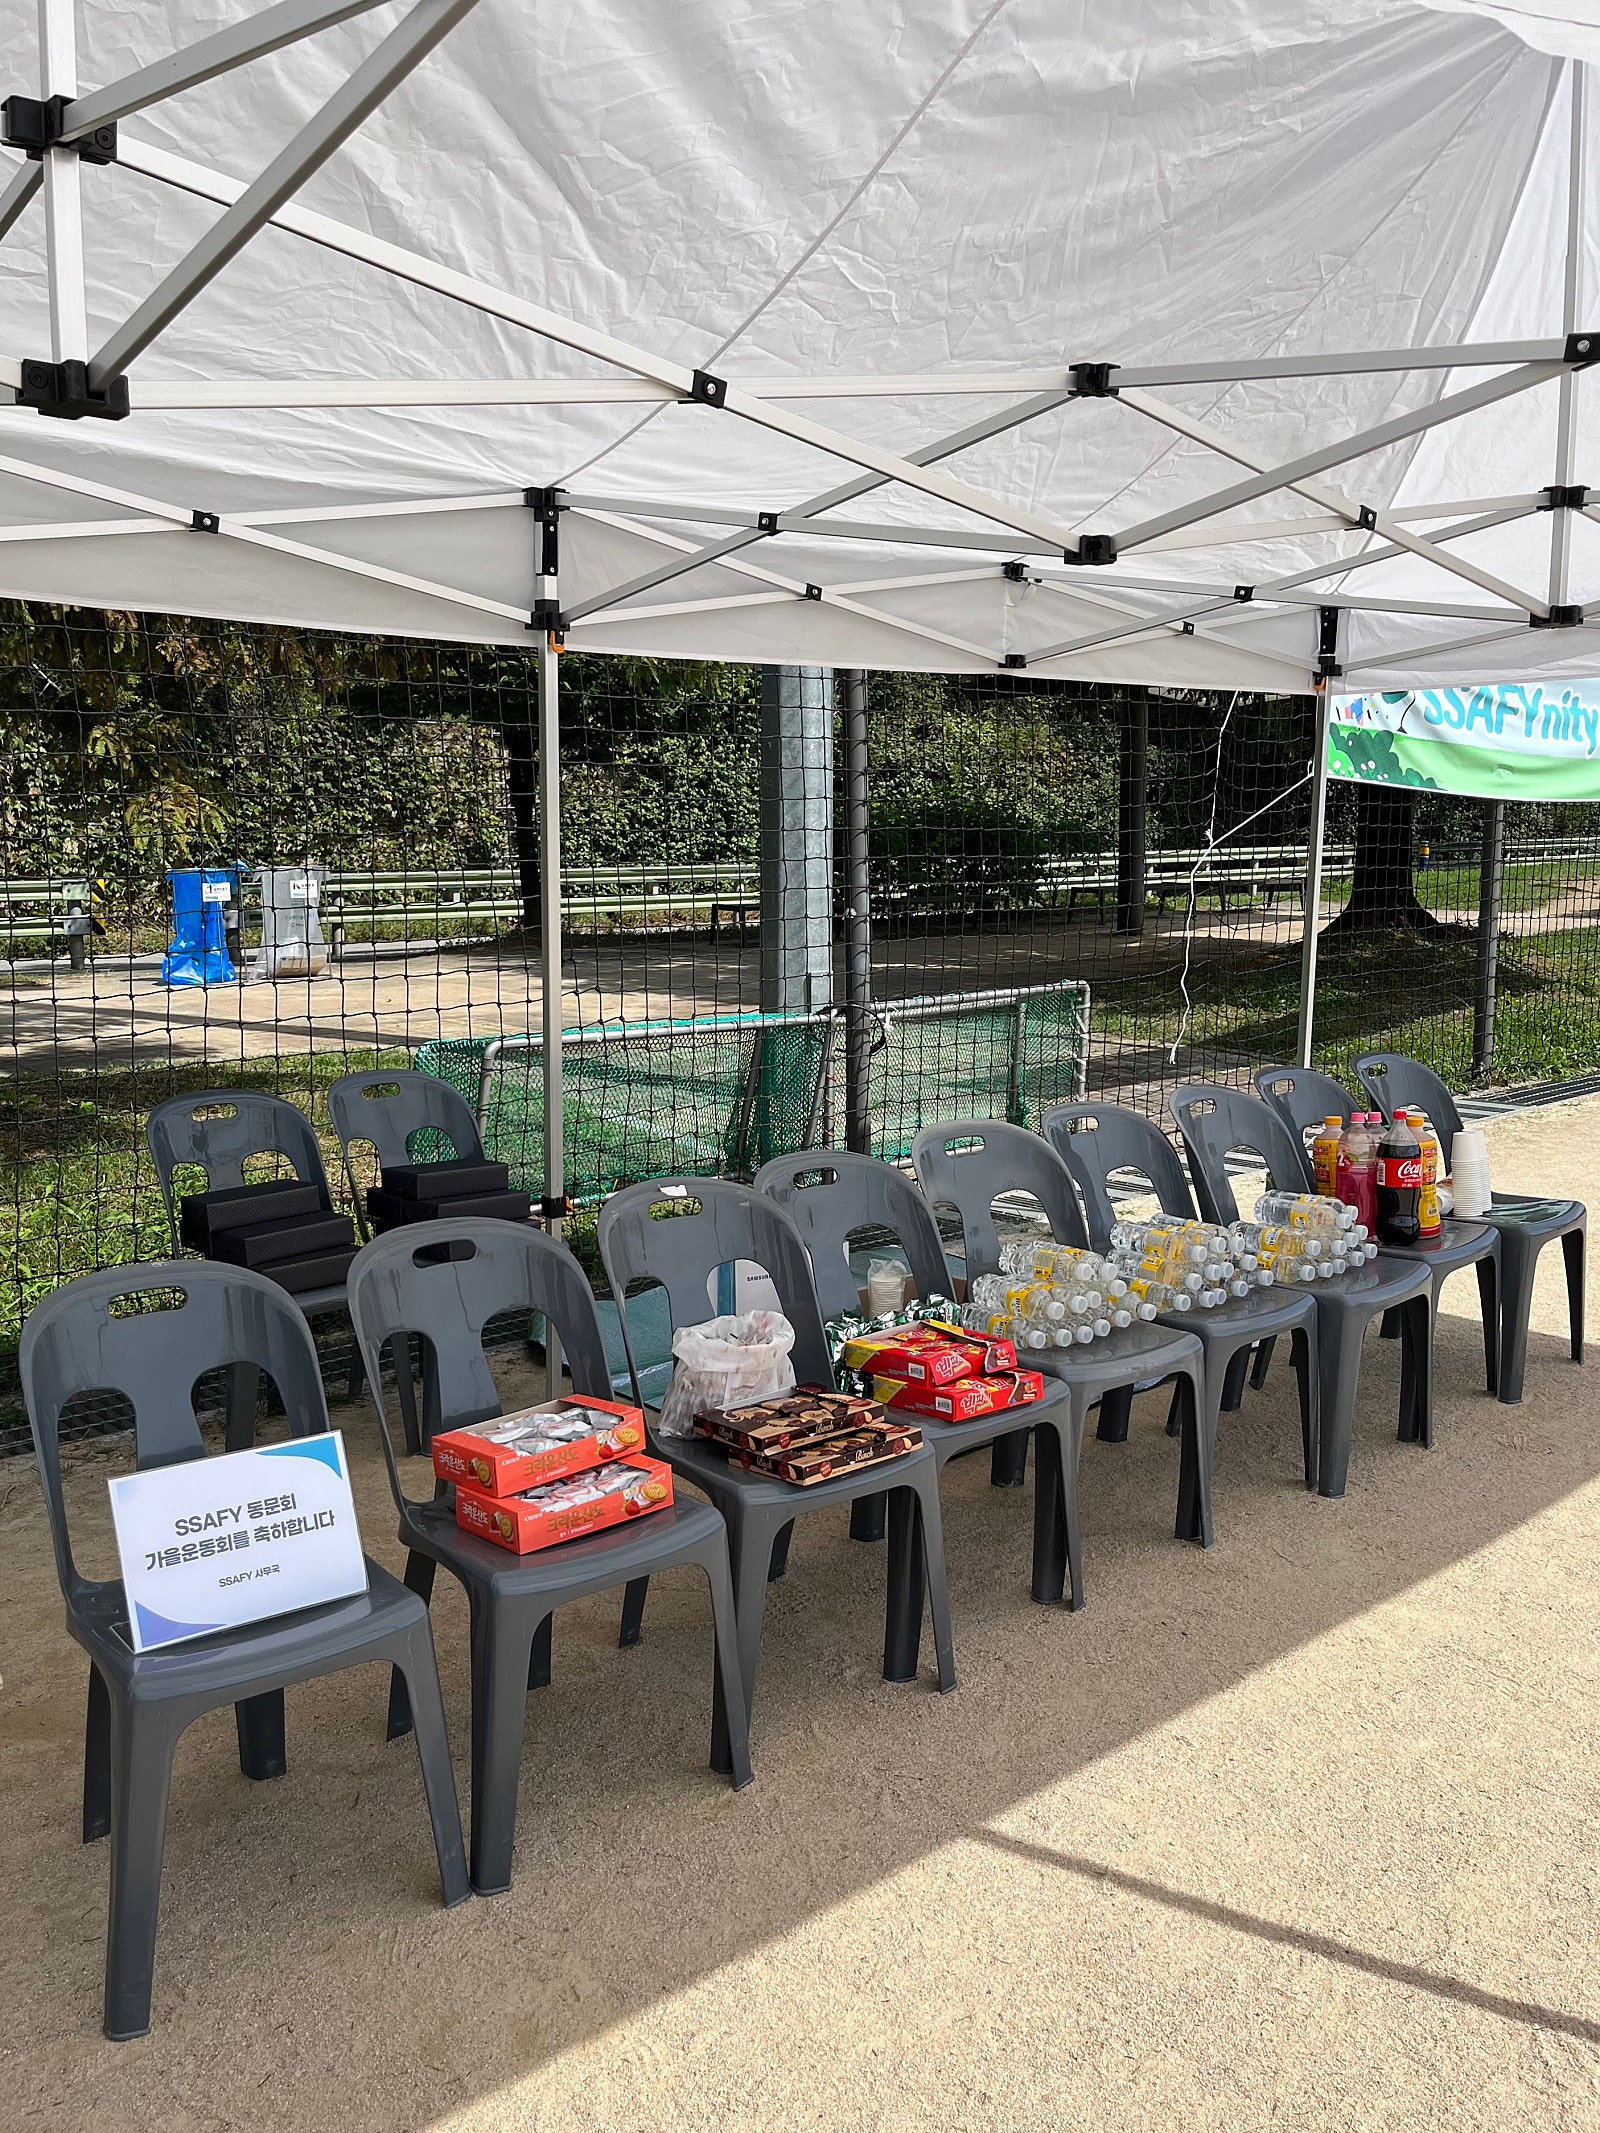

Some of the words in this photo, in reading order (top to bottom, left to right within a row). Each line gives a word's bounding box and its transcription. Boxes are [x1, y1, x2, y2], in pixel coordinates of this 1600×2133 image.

[747, 1274, 770, 1282] SAMSUN
[524, 1446, 580, 1477] 크라운산도
[174, 1505, 243, 1537] SSAFY
[247, 1493, 297, 1520] 동문회
[547, 1502, 606, 1534] 크라운산도
[145, 1530, 251, 1571] 가을운동회를
[253, 1509, 336, 1543] 축하합니다
[218, 1570, 253, 1588] SSAFY
[254, 1563, 281, 1578] 사무국
